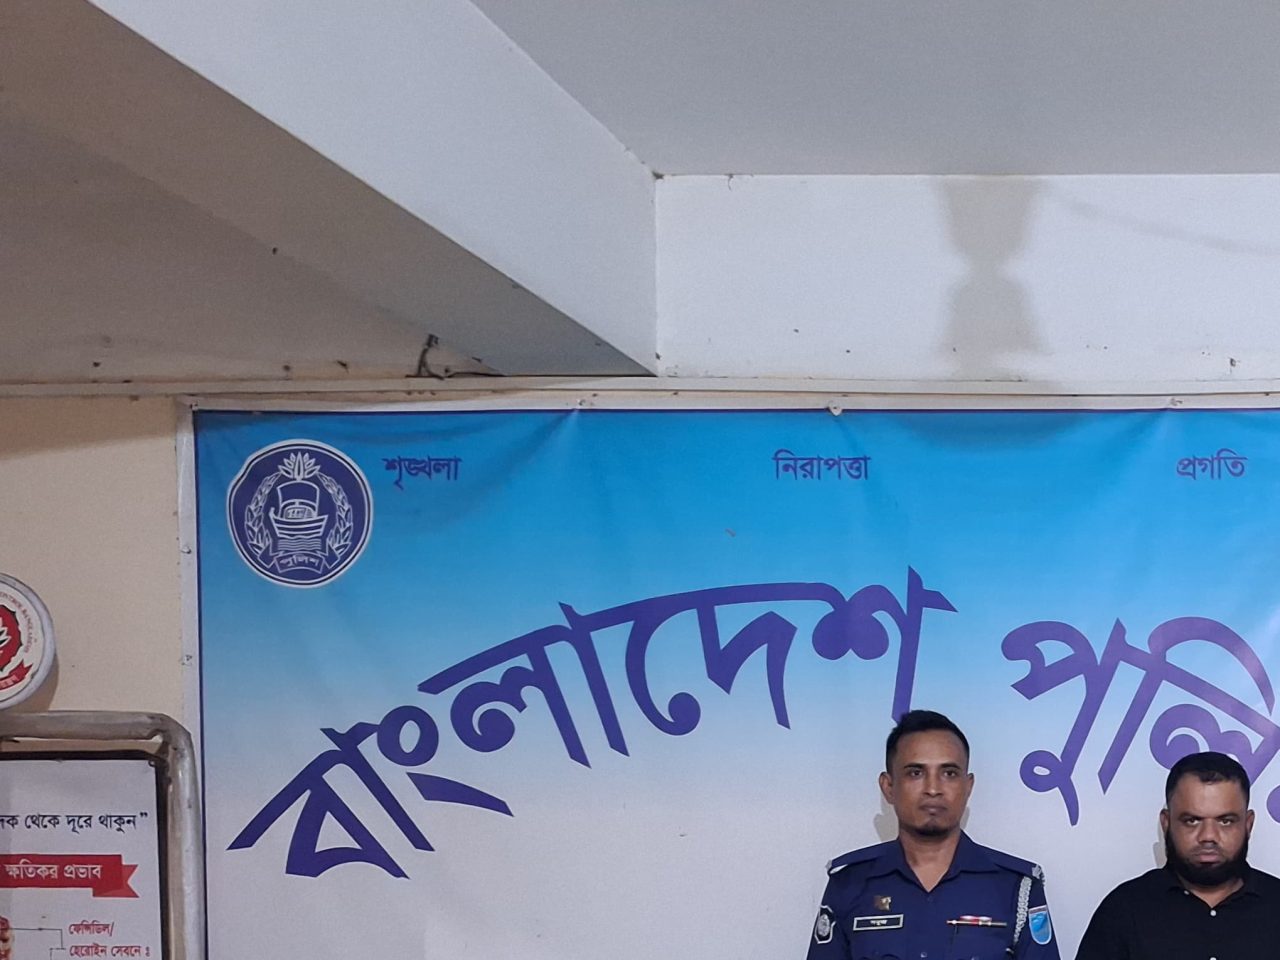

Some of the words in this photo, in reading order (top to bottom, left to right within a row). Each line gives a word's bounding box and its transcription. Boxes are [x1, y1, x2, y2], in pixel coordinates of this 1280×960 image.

[773, 449, 871, 481] নিরাপত্তা
[1176, 448, 1248, 480] প্রগতি
[227, 566, 957, 879] বাংলাদেশ
[25, 813, 62, 829] থেকে
[66, 814, 93, 834] দূরে
[4, 858, 59, 879] ক্ষতিকর
[64, 863, 103, 879] প্রভাব
[70, 943, 107, 957] হেরোইন
[111, 945, 141, 957] সেবনে
